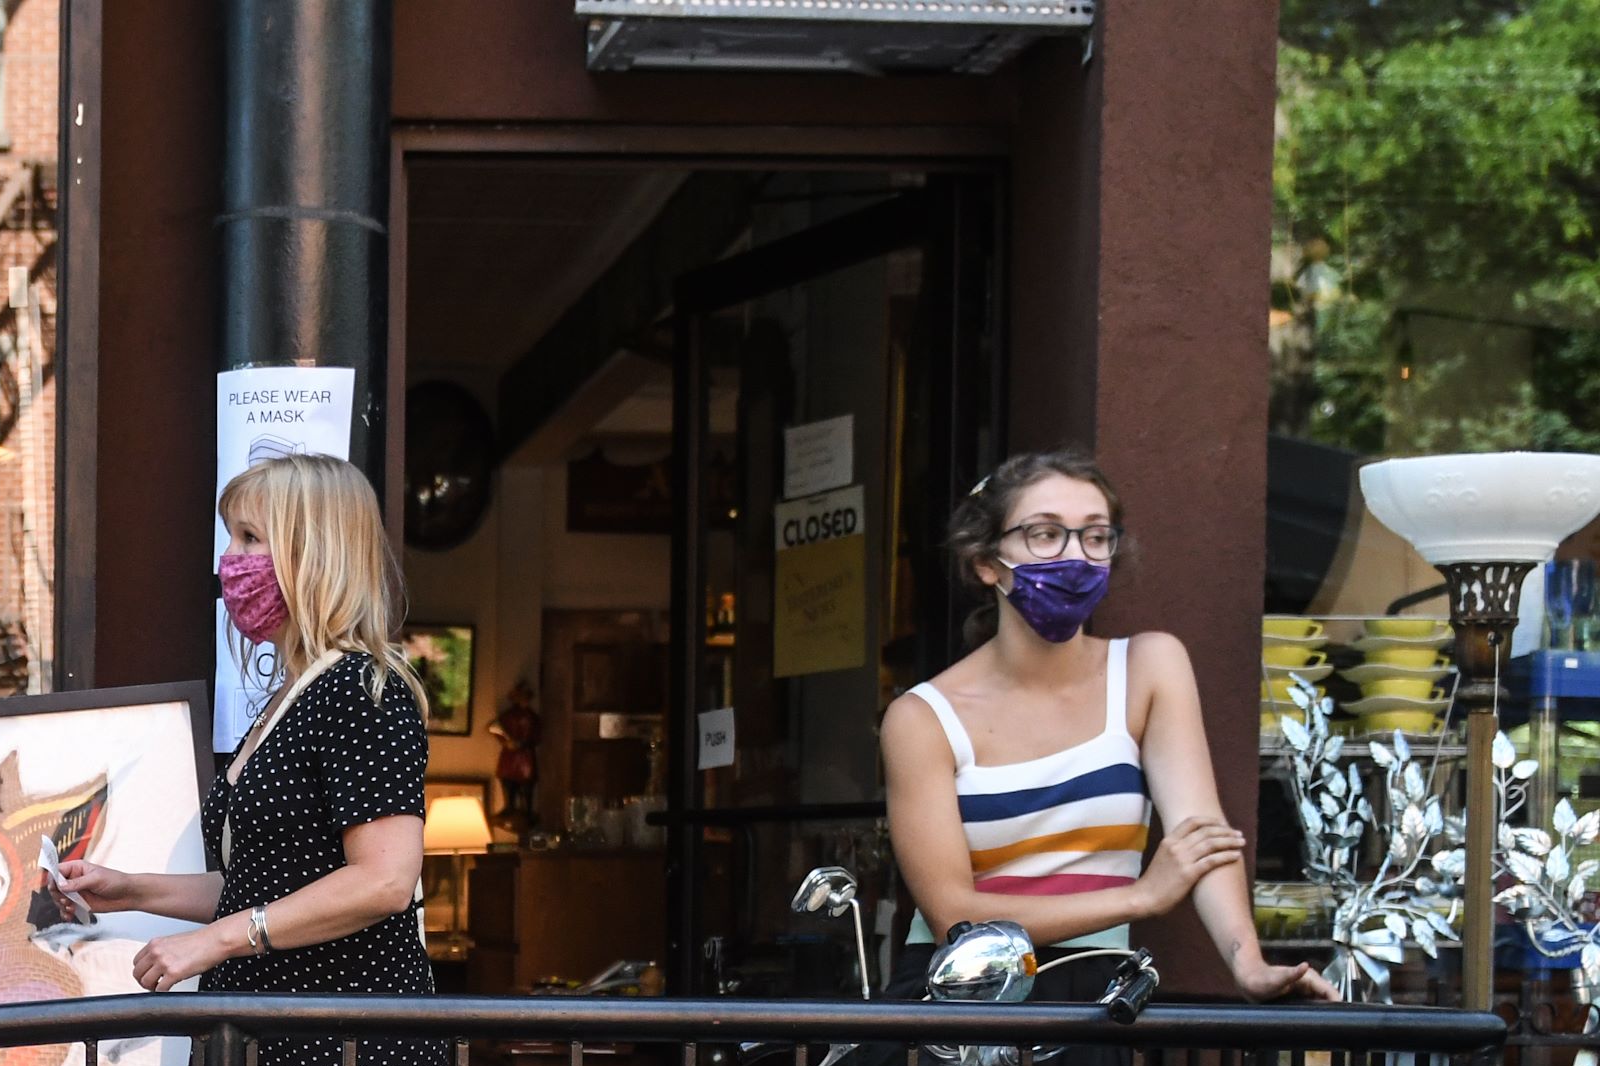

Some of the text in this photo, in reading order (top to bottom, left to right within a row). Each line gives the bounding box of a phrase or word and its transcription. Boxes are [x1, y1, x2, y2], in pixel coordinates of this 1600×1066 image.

[228, 389, 332, 406] PLEASE WEAR
[245, 409, 305, 424] A MASK
[783, 508, 857, 547] CLOSED
[704, 731, 726, 747] PUSH
